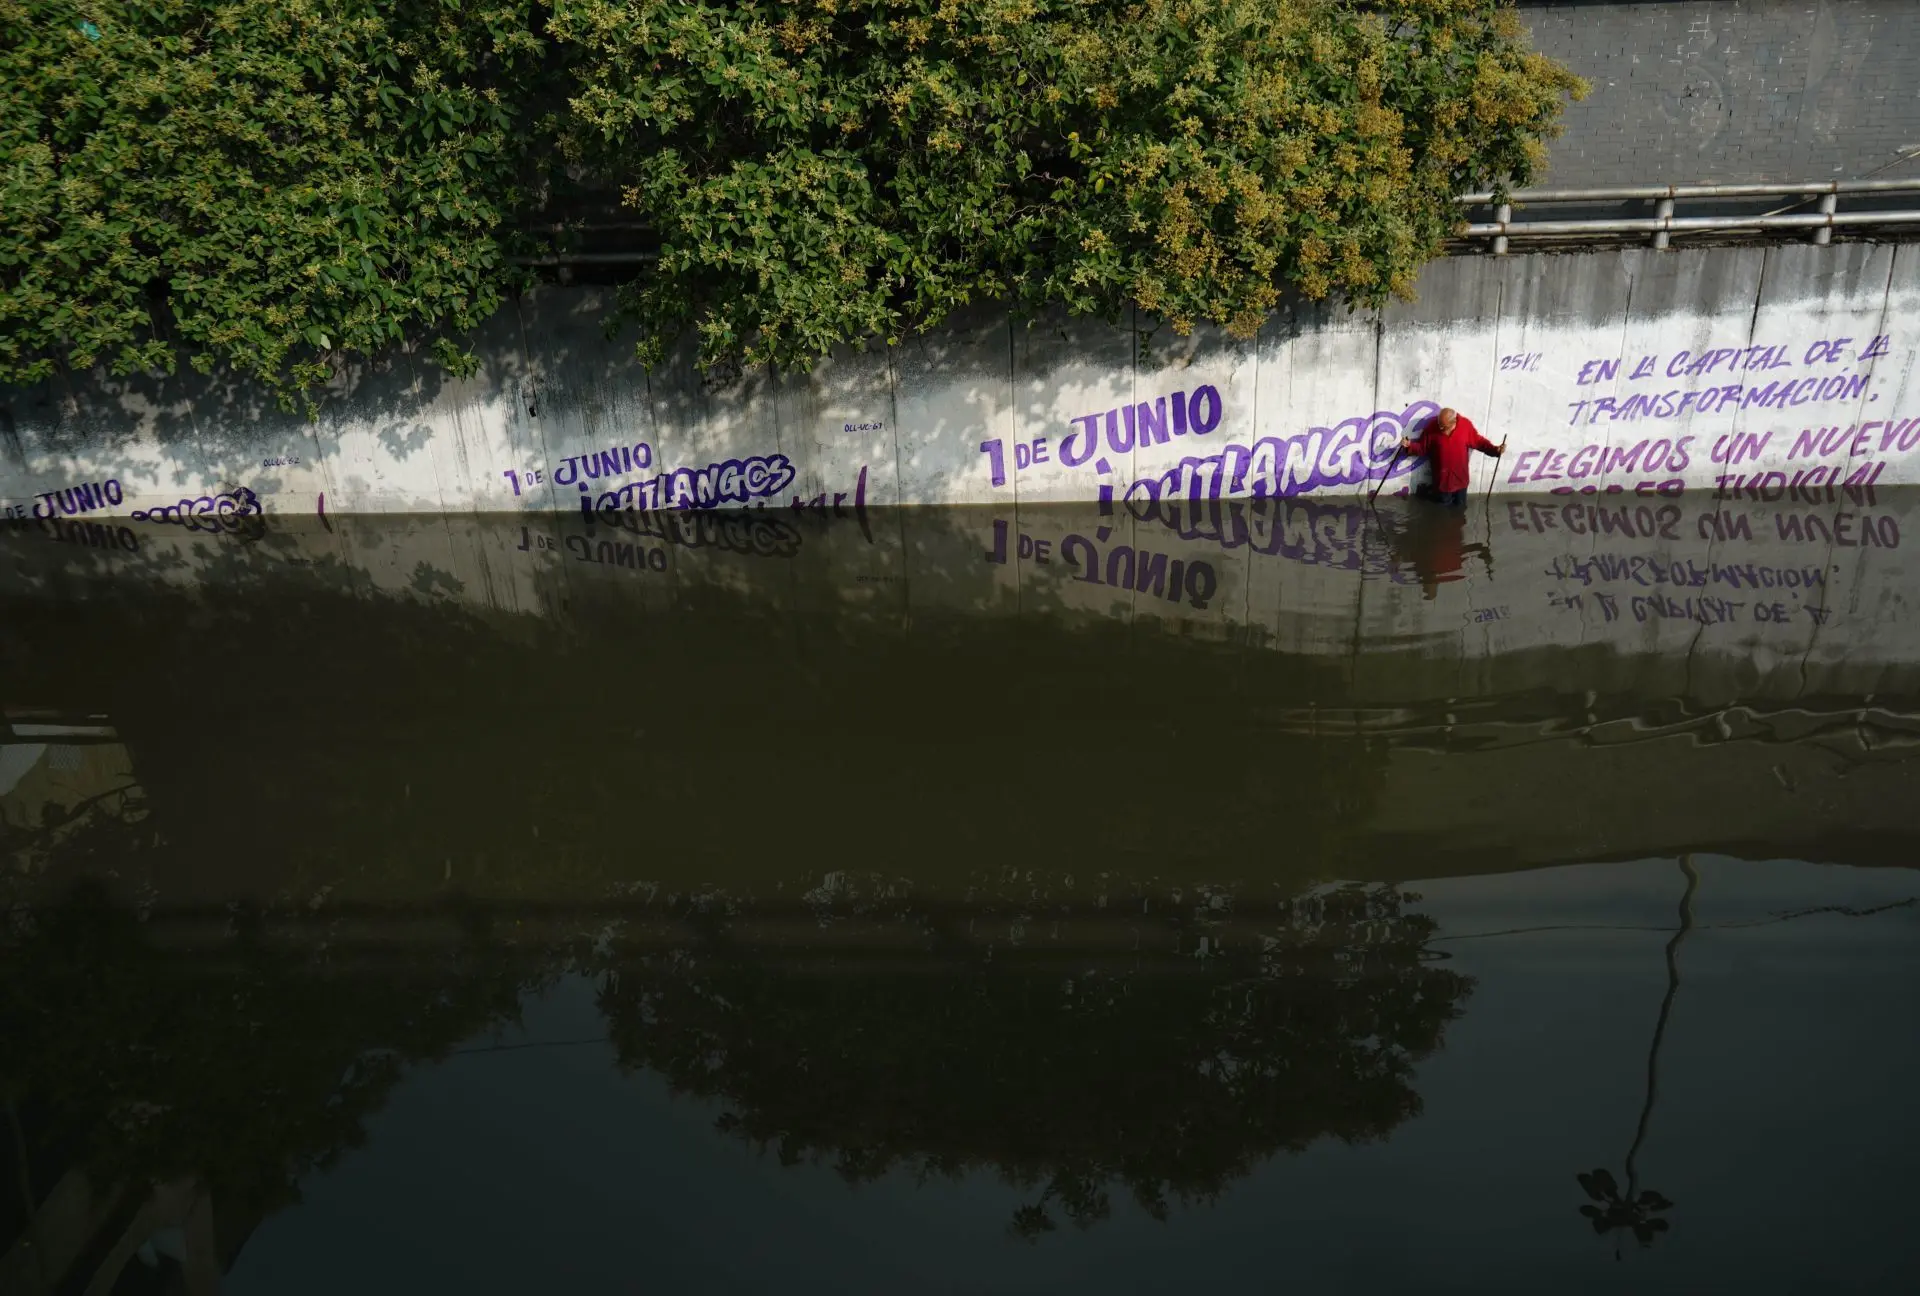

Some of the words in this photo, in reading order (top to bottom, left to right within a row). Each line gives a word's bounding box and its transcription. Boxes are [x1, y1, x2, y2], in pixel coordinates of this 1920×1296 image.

[1576, 358, 1622, 386] EN
[1629, 355, 1657, 380] LA
[1666, 345, 1792, 378] CAPITAL
[1804, 338, 1854, 365] DE
[1858, 335, 1891, 358] LA
[980, 439, 1006, 487] 1
[1016, 437, 1047, 469] DE
[1058, 384, 1222, 467] JUNIO
[1507, 435, 1695, 484] ELEGIMOS
[1710, 431, 1774, 464] UN
[503, 470, 521, 497] 1
[526, 471, 543, 487] DE
[554, 442, 652, 486] JUNIO
[32, 479, 123, 519] JUNIO
